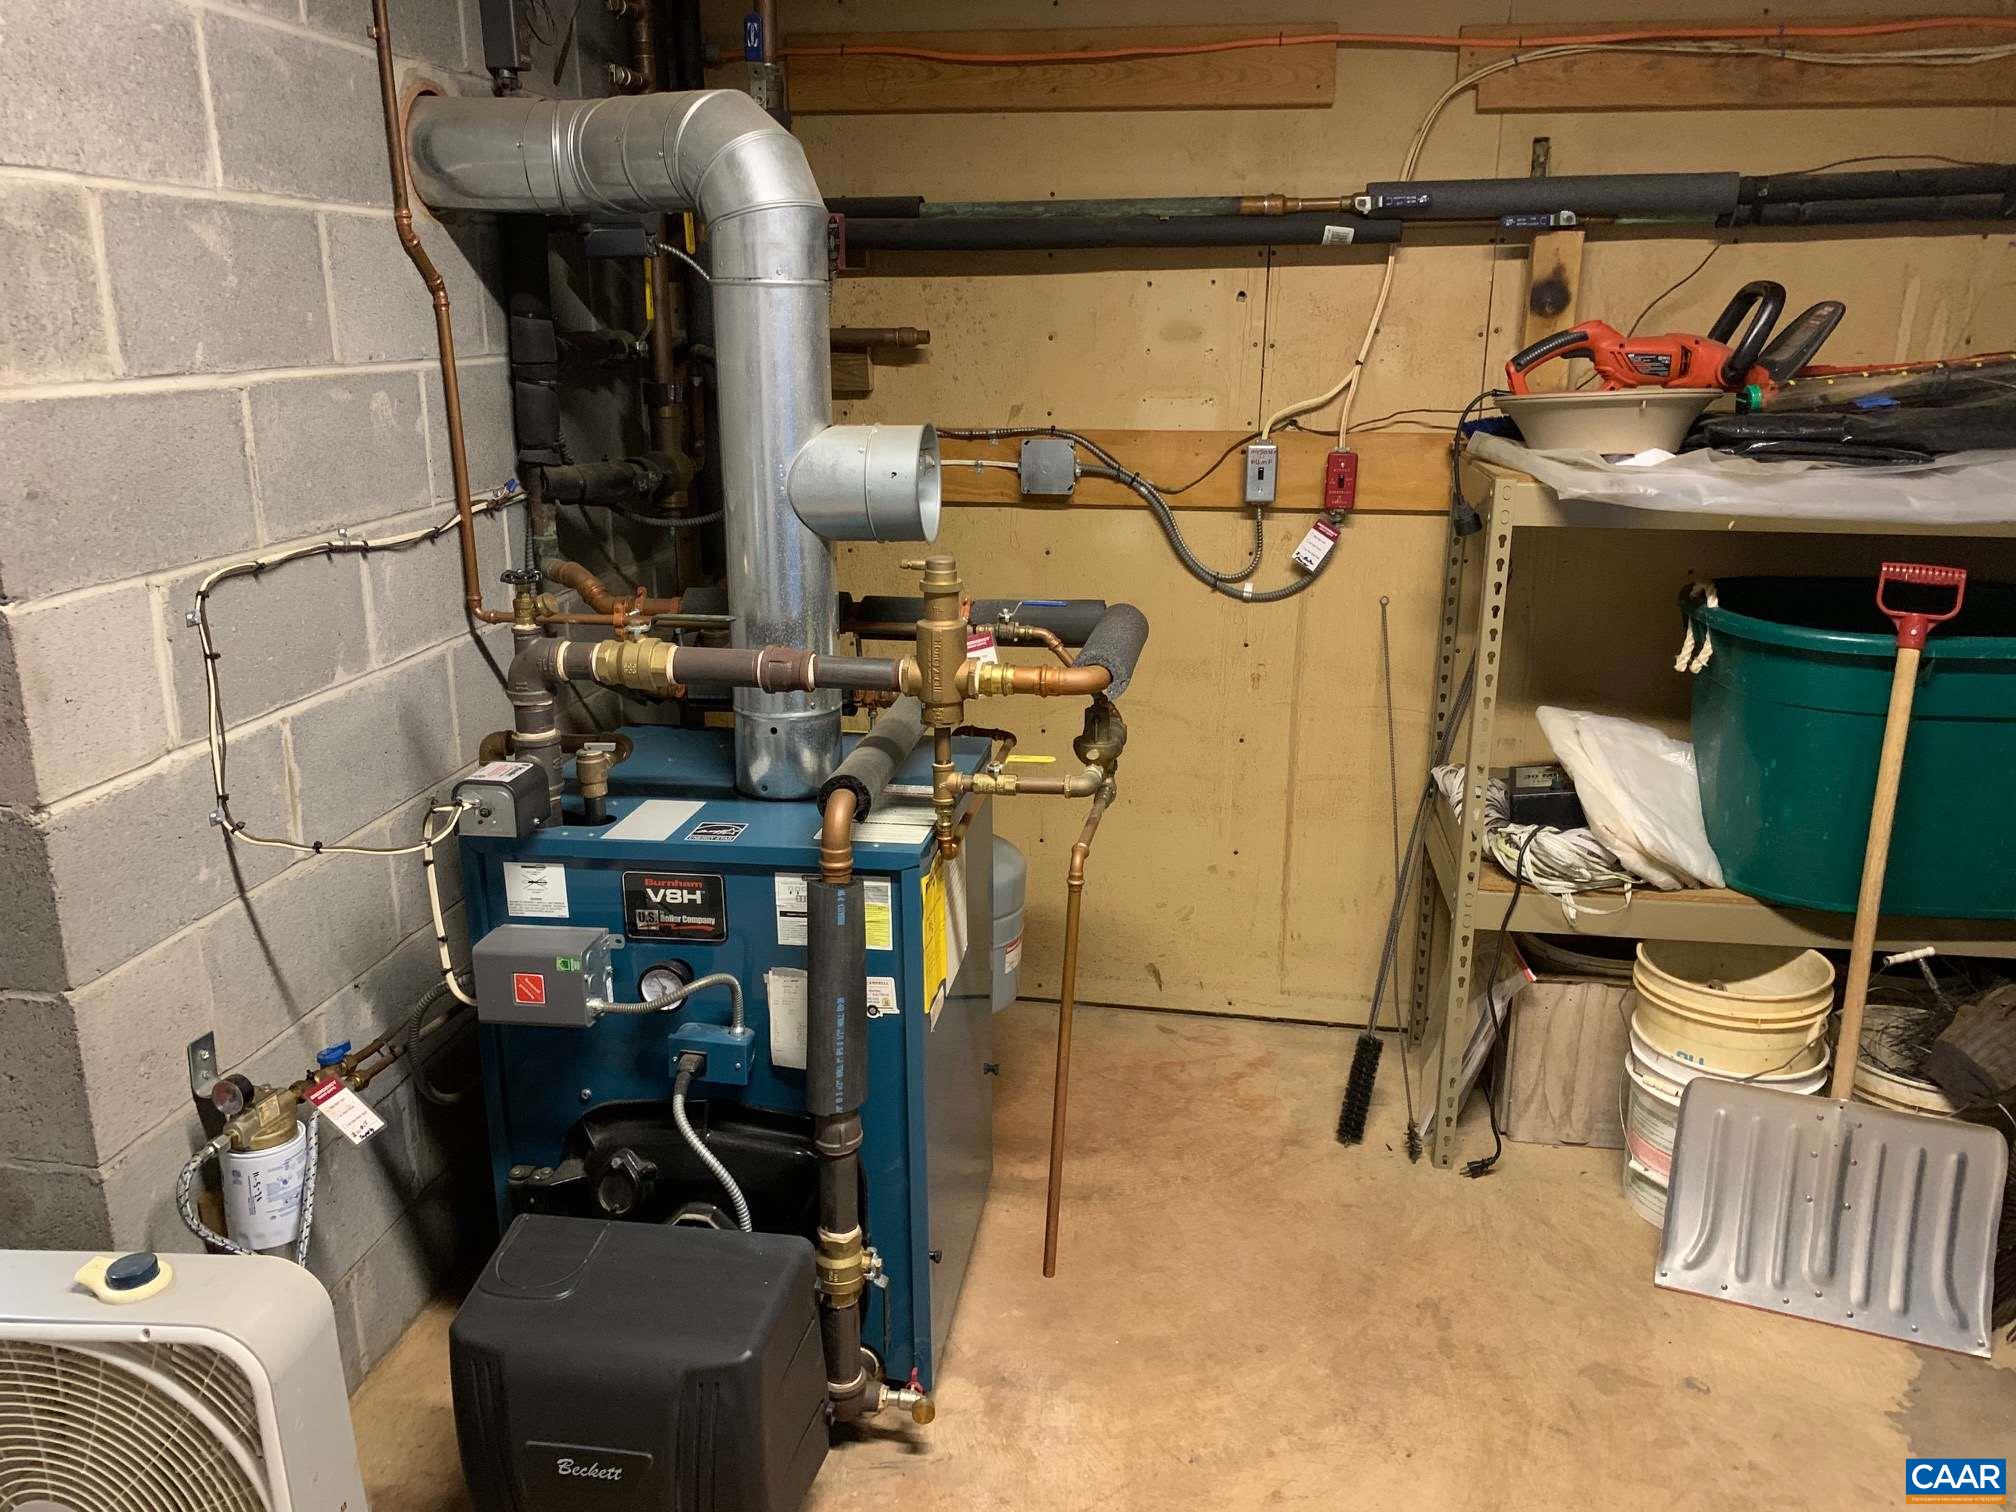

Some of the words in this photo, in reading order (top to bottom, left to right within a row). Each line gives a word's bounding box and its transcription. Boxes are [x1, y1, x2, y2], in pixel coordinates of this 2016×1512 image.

[932, 640, 943, 692] Honeywell
[643, 877, 703, 888] Burnham
[682, 914, 716, 926] Company
[557, 1458, 623, 1481] Beckett
